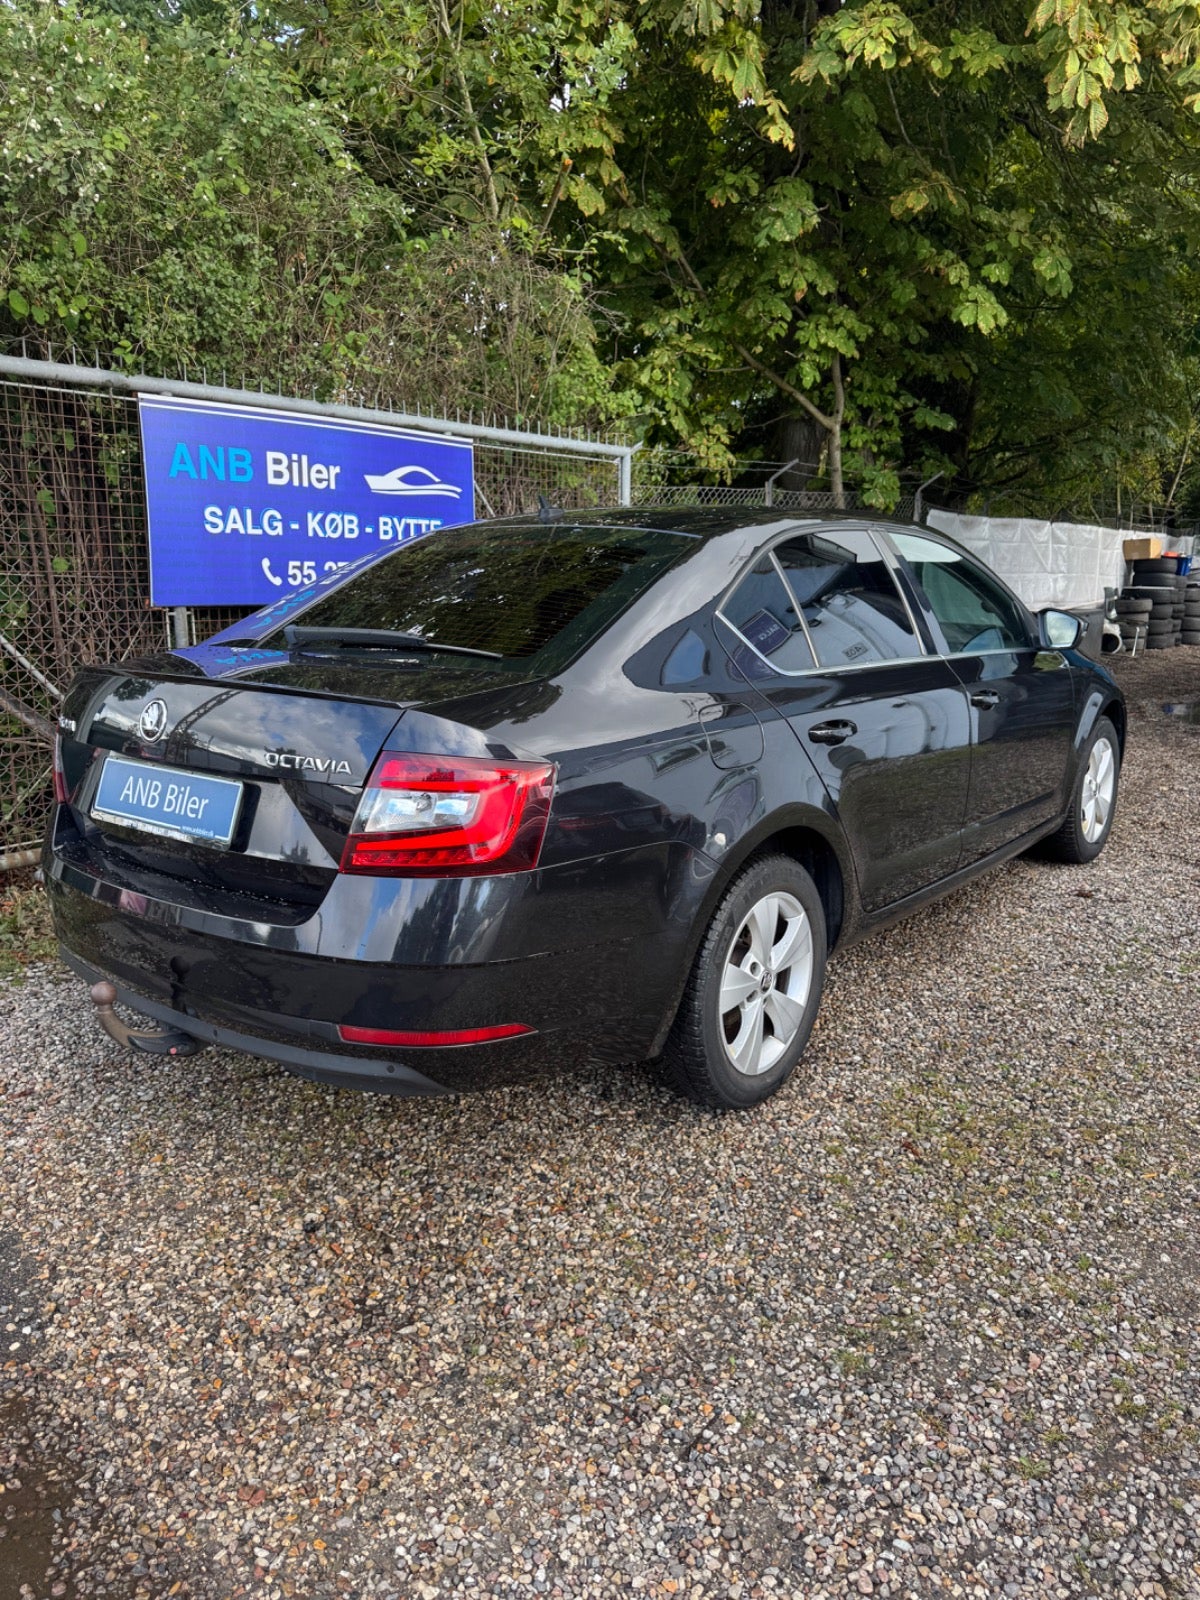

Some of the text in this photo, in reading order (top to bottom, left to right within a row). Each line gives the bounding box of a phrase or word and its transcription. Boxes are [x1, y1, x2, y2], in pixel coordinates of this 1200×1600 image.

[169, 442, 340, 490] ANB Biler
[203, 505, 283, 536] SALG
[307, 511, 359, 539] KØB
[287, 561, 317, 586] 55
[265, 752, 352, 775] OCTAVIA
[120, 776, 209, 819] ANB Biler
